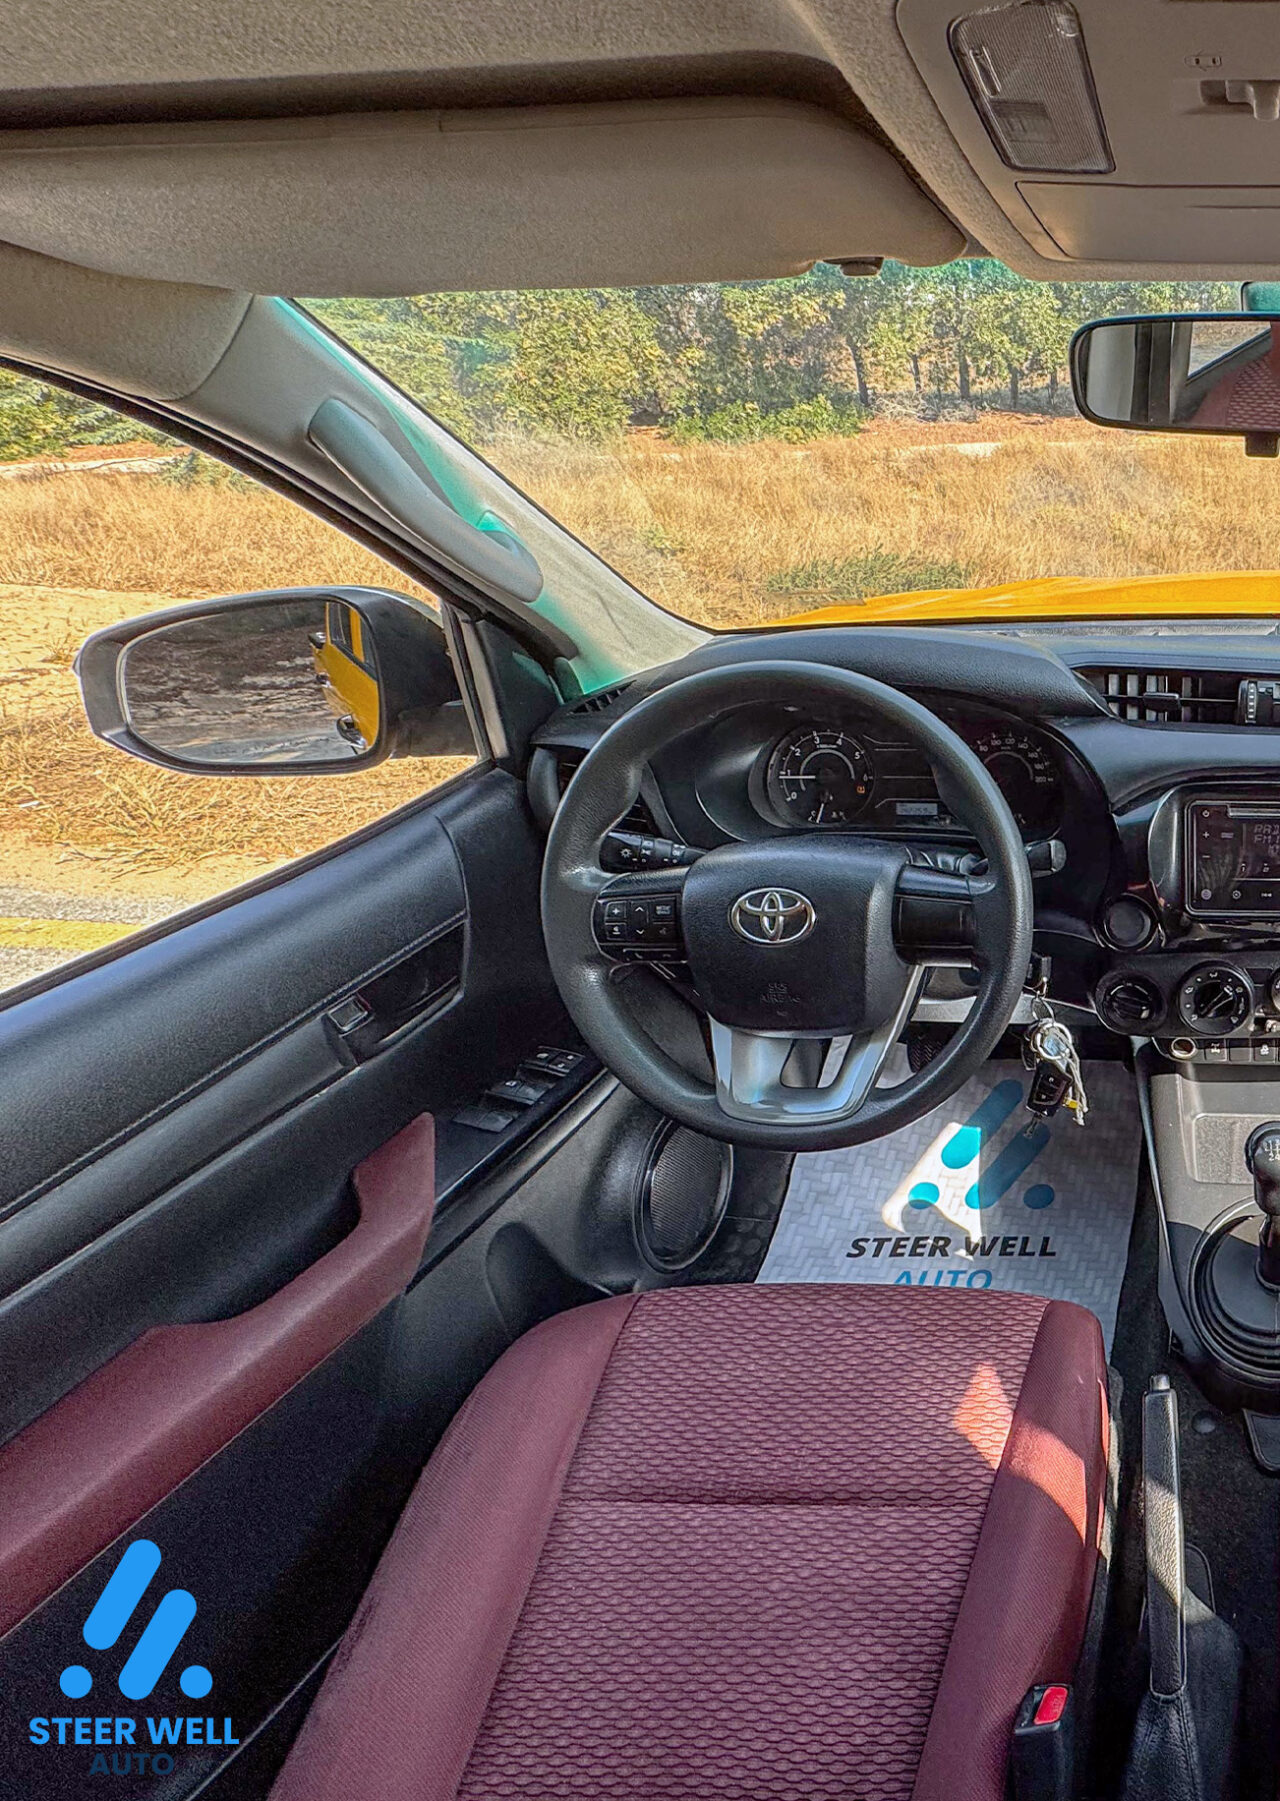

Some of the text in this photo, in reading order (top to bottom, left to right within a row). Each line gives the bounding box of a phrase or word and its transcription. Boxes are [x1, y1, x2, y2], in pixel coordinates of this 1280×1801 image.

[846, 1235, 1057, 1258] STEER WELL
[893, 1269, 993, 1289] AUTO
